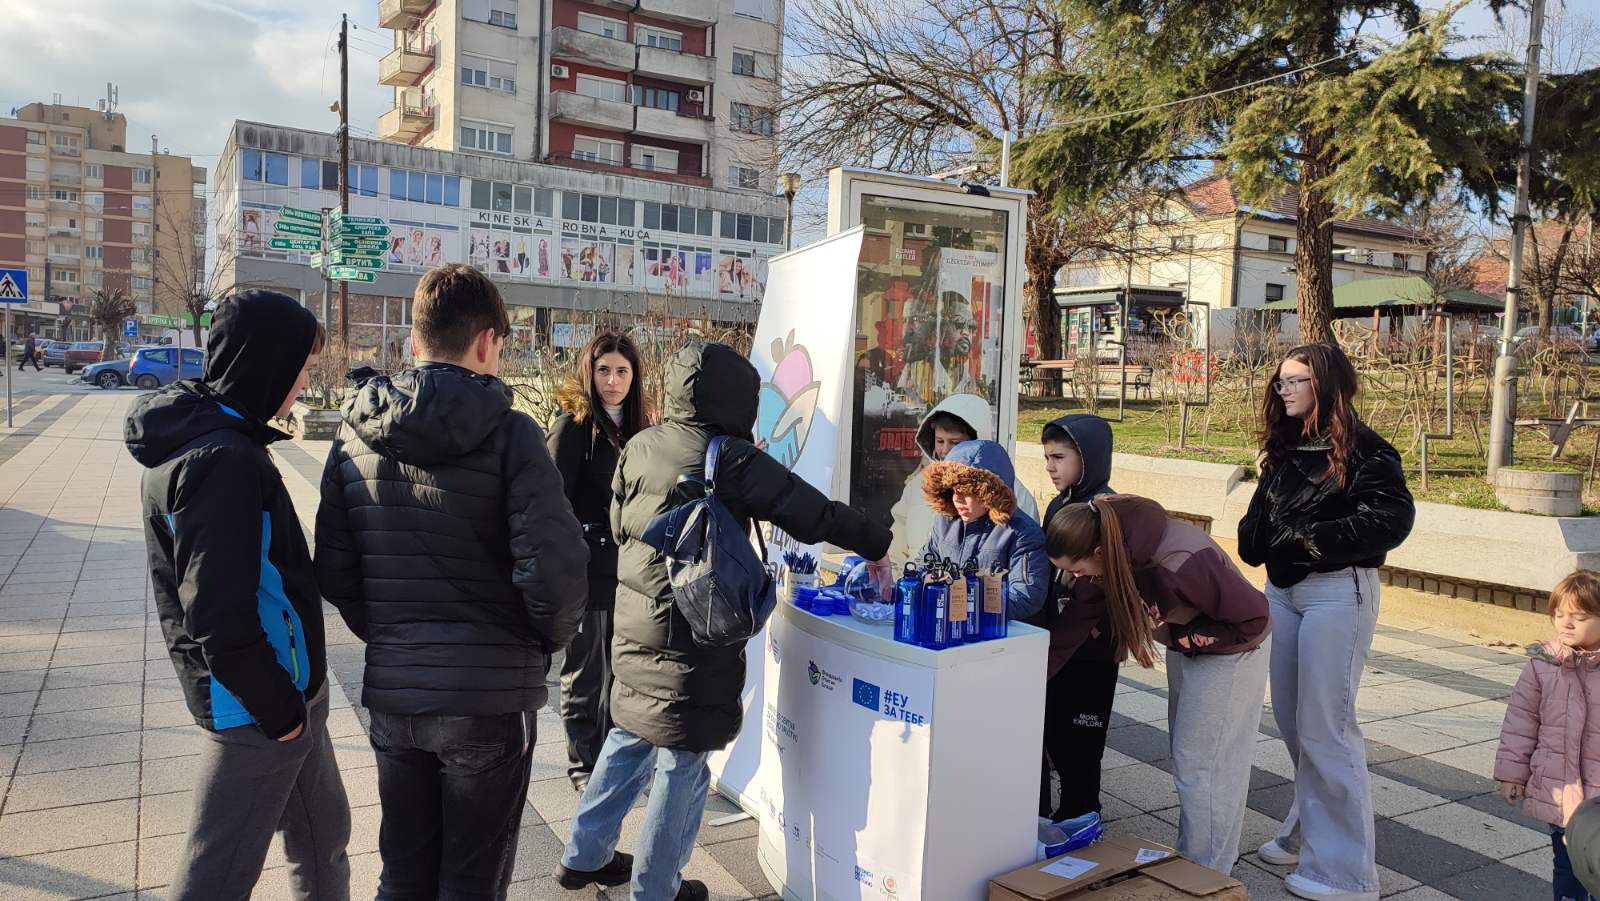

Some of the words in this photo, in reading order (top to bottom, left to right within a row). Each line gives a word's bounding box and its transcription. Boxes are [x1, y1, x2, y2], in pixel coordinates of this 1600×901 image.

[479, 211, 544, 228] KINESKA
[562, 221, 607, 235] ROBNA
[884, 689, 909, 708] #ЕУ
[884, 703, 897, 718] ЗА
[899, 708, 925, 727] ТЕБЕ
[1072, 718, 1104, 728] EXPLORE
[1079, 713, 1099, 721] MORE
